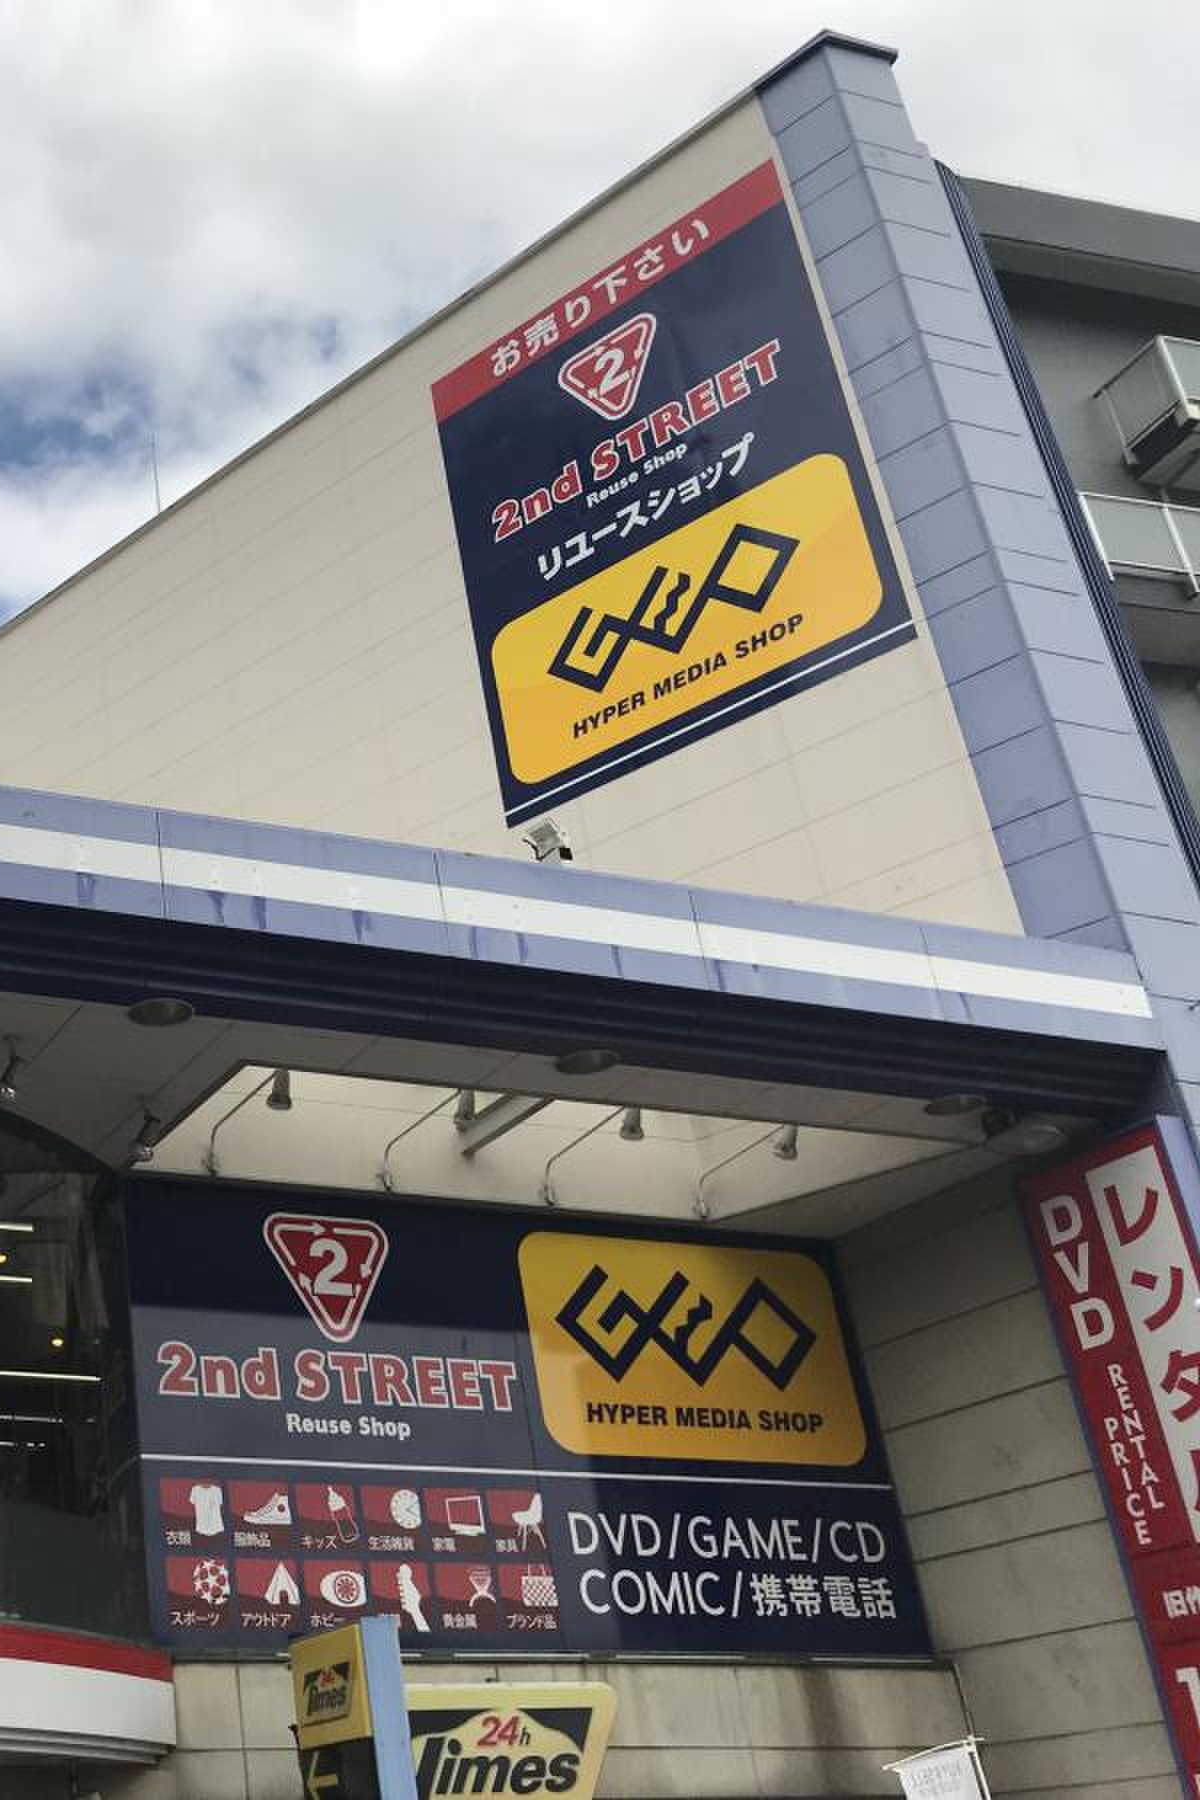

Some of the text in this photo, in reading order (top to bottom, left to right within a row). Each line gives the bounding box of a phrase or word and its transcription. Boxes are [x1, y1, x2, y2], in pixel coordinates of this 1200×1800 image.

[490, 219, 709, 377] お売り下さい
[593, 349, 631, 394] 2
[492, 337, 781, 542] 2nd STREET
[586, 443, 688, 508] Reuse Shop
[538, 431, 755, 580] リユースショップ
[547, 524, 800, 693] GEO
[572, 614, 804, 739] HYPER MEDIA SHOP
[309, 1238, 357, 1297] 2
[1040, 1195, 1115, 1350] DVD
[555, 1265, 817, 1392] GEO
[158, 1341, 516, 1412] 2nd STREET
[286, 1412, 412, 1440] Reuse Shop
[586, 1401, 824, 1434] HYPER MEDIA SHOP
[1107, 1363, 1165, 1510] RENTAL
[1104, 1417, 1152, 1546] PRICE
[301, 1535, 338, 1550] キッズ
[567, 1511, 886, 1563] DVD/GAME/CD
[170, 1611, 221, 1627] スポーツ
[241, 1613, 292, 1628] アウトドア
[310, 1614, 345, 1628] ホビー
[506, 1614, 557, 1629] ブランド品
[580, 1570, 896, 1619] COMIC/携帯電話
[477, 1715, 531, 1748] 24h
